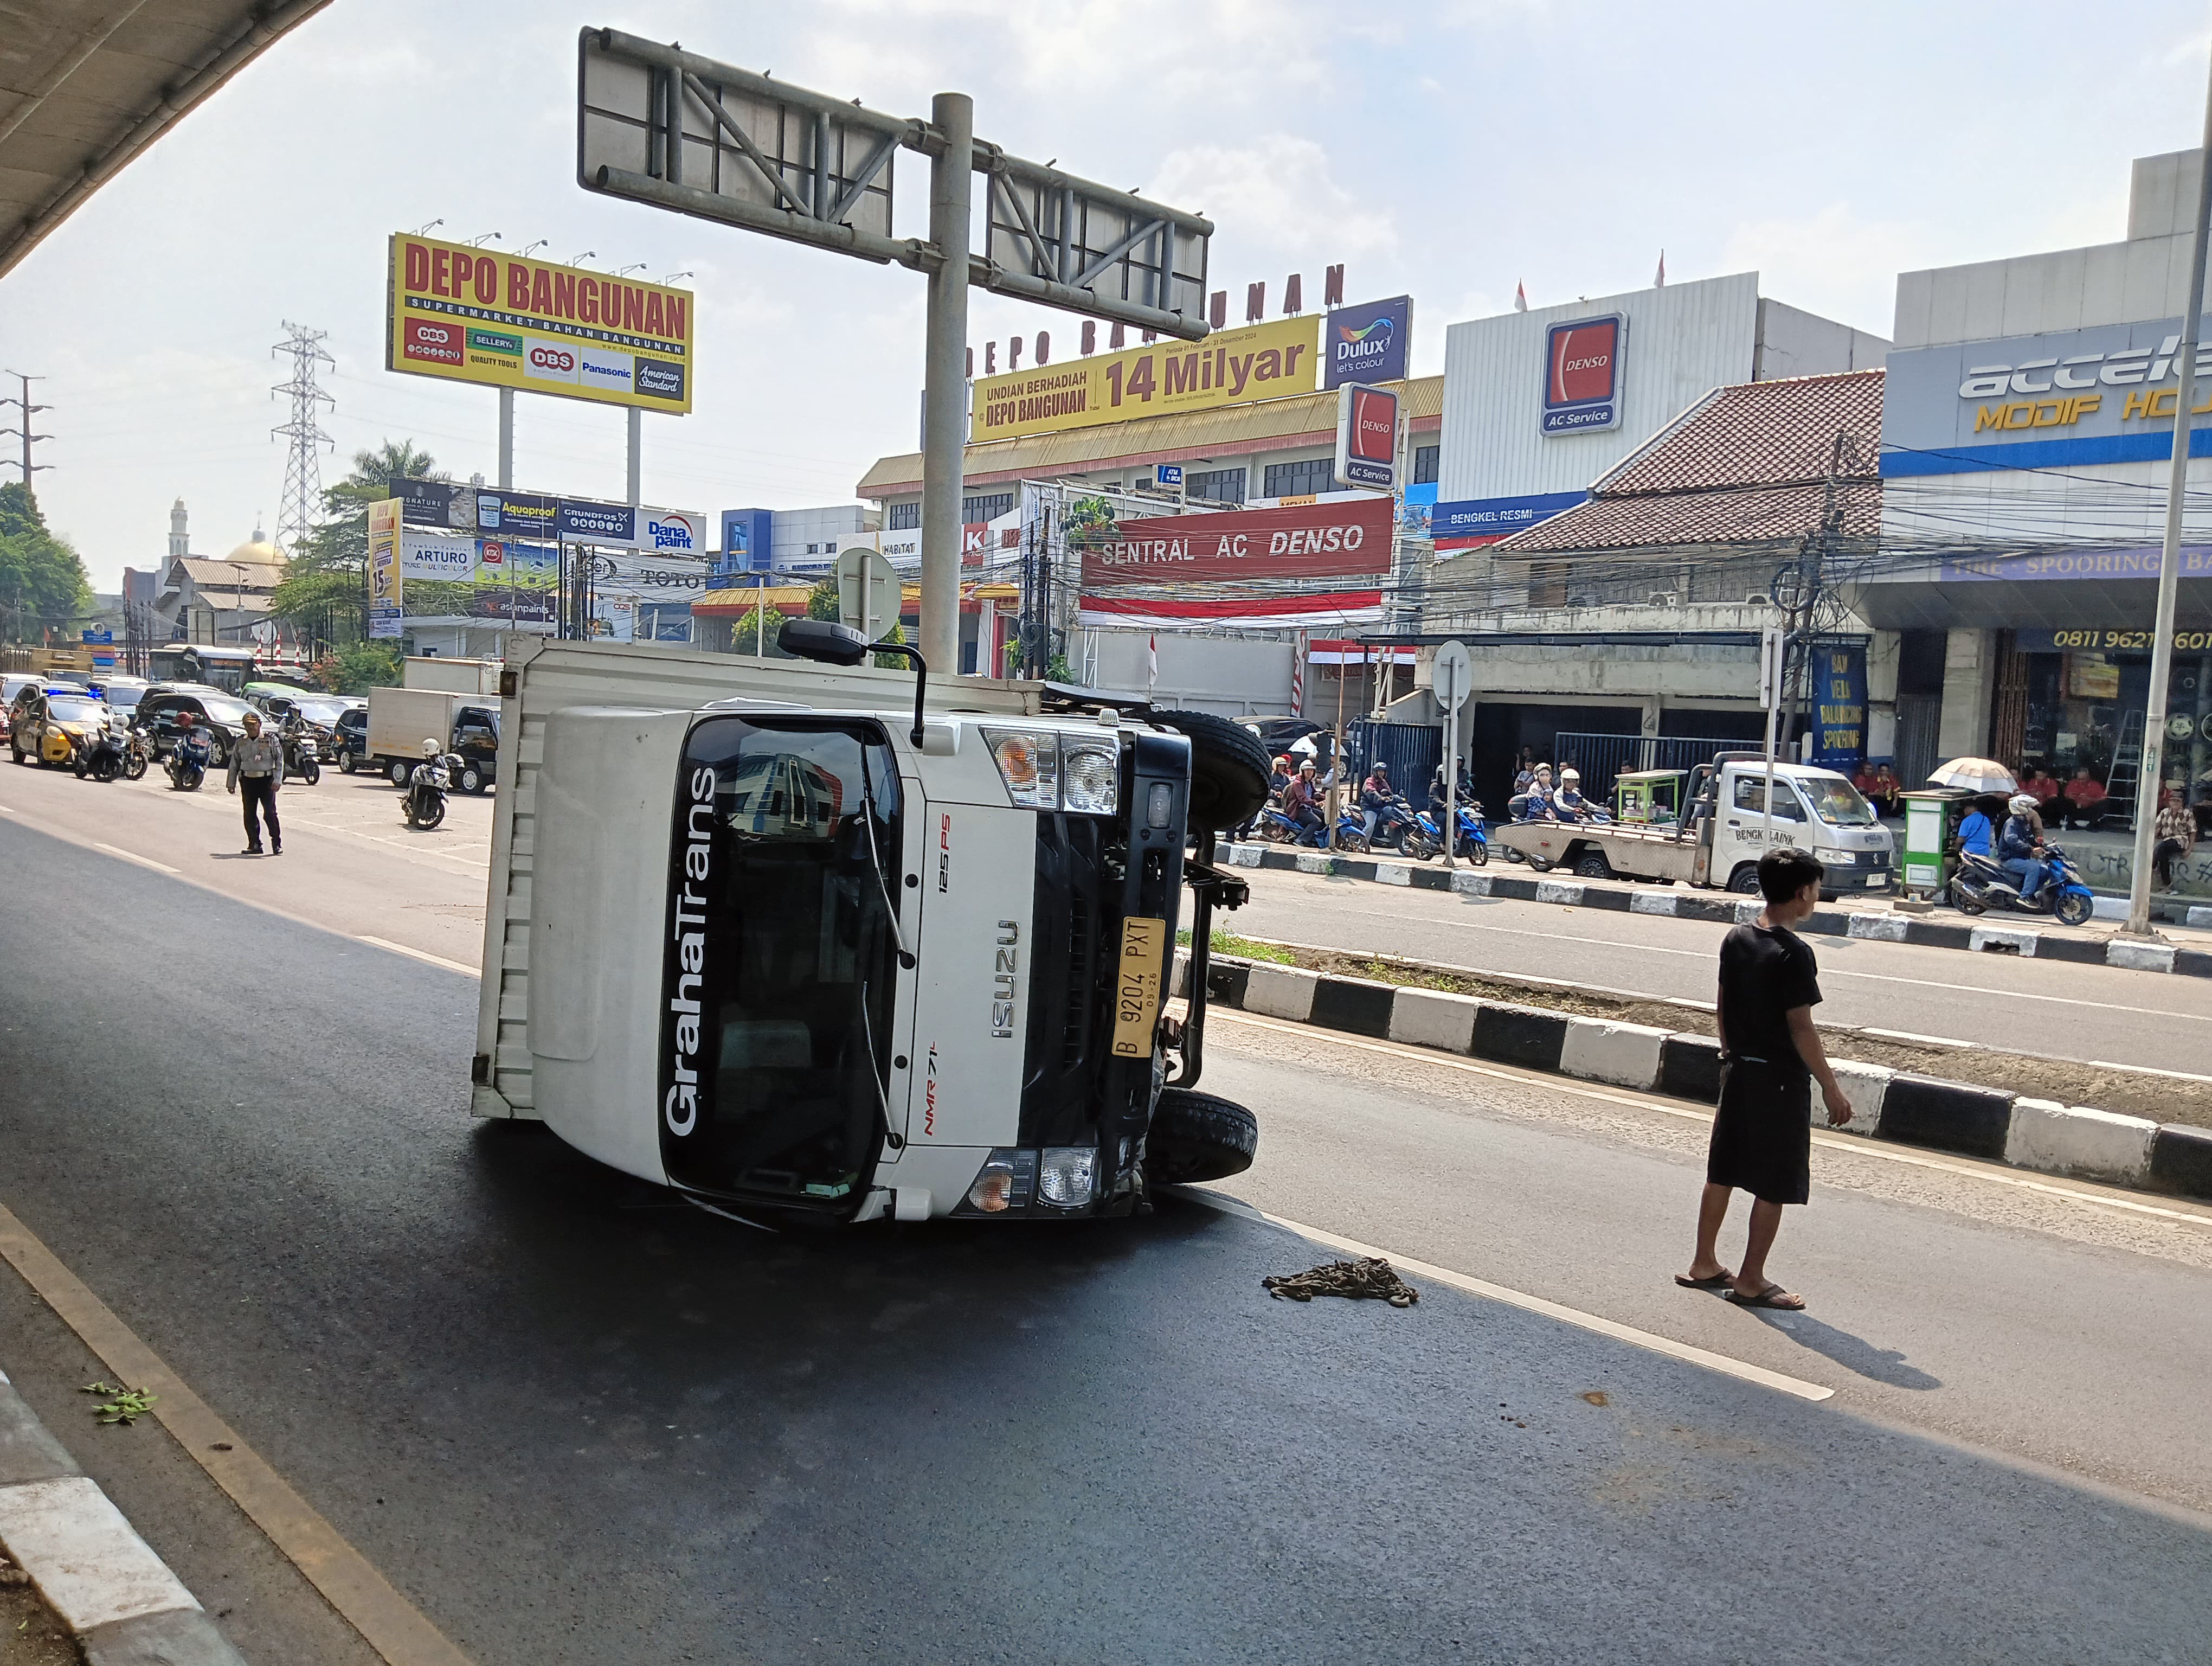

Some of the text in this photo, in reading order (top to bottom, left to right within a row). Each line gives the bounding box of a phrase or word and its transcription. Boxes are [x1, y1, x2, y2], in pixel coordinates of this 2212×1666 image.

[406, 243, 685, 340] DEPO BANGUNAN
[411, 298, 681, 354] SUPERMARKET BAHAN BANGUNAN
[421, 330, 446, 340] DBS
[476, 336, 510, 348] SELLERY
[1337, 338, 1385, 361] Dulux
[471, 355, 517, 369] QUALITY TOOLS
[534, 351, 570, 368] DBS
[1337, 357, 1385, 374] let's colour
[1566, 355, 1608, 371] DENSO
[582, 362, 632, 378] Panasonic
[640, 366, 680, 382] American
[1106, 344, 1306, 408] 14 Milyar
[639, 376, 678, 392] Standard
[987, 371, 1087, 401] UNDIAN BERHADIAH
[986, 401, 1015, 427] DEPO
[1018, 388, 1086, 422] BANGUNAN
[1974, 394, 2102, 432] MODIF
[1362, 420, 1390, 434] DENSO
[1548, 411, 1608, 427] AC Service
[1350, 466, 1390, 481] AC Service
[502, 501, 557, 518] Aquaproof
[564, 509, 617, 521] GRUNDFOS
[1450, 508, 1533, 524] BENGKEL RESMI
[648, 521, 686, 539] Dana
[655, 535, 692, 549] paint
[1102, 524, 1364, 566] SENTRAL AC DENSO
[415, 550, 467, 563] ARTURO
[2026, 554, 2160, 574] SPOORING
[423, 563, 468, 572] MULTICOLOR
[373, 569, 384, 594] 15
[641, 569, 699, 589] TOTO
[2054, 631, 2100, 647] 0811
[666, 766, 716, 1136] GrahaTrans
[991, 919, 1020, 1038] ISUZU
[1115, 921, 1150, 1054] B 9204 PXT
[924, 1080, 937, 1137] NMR
